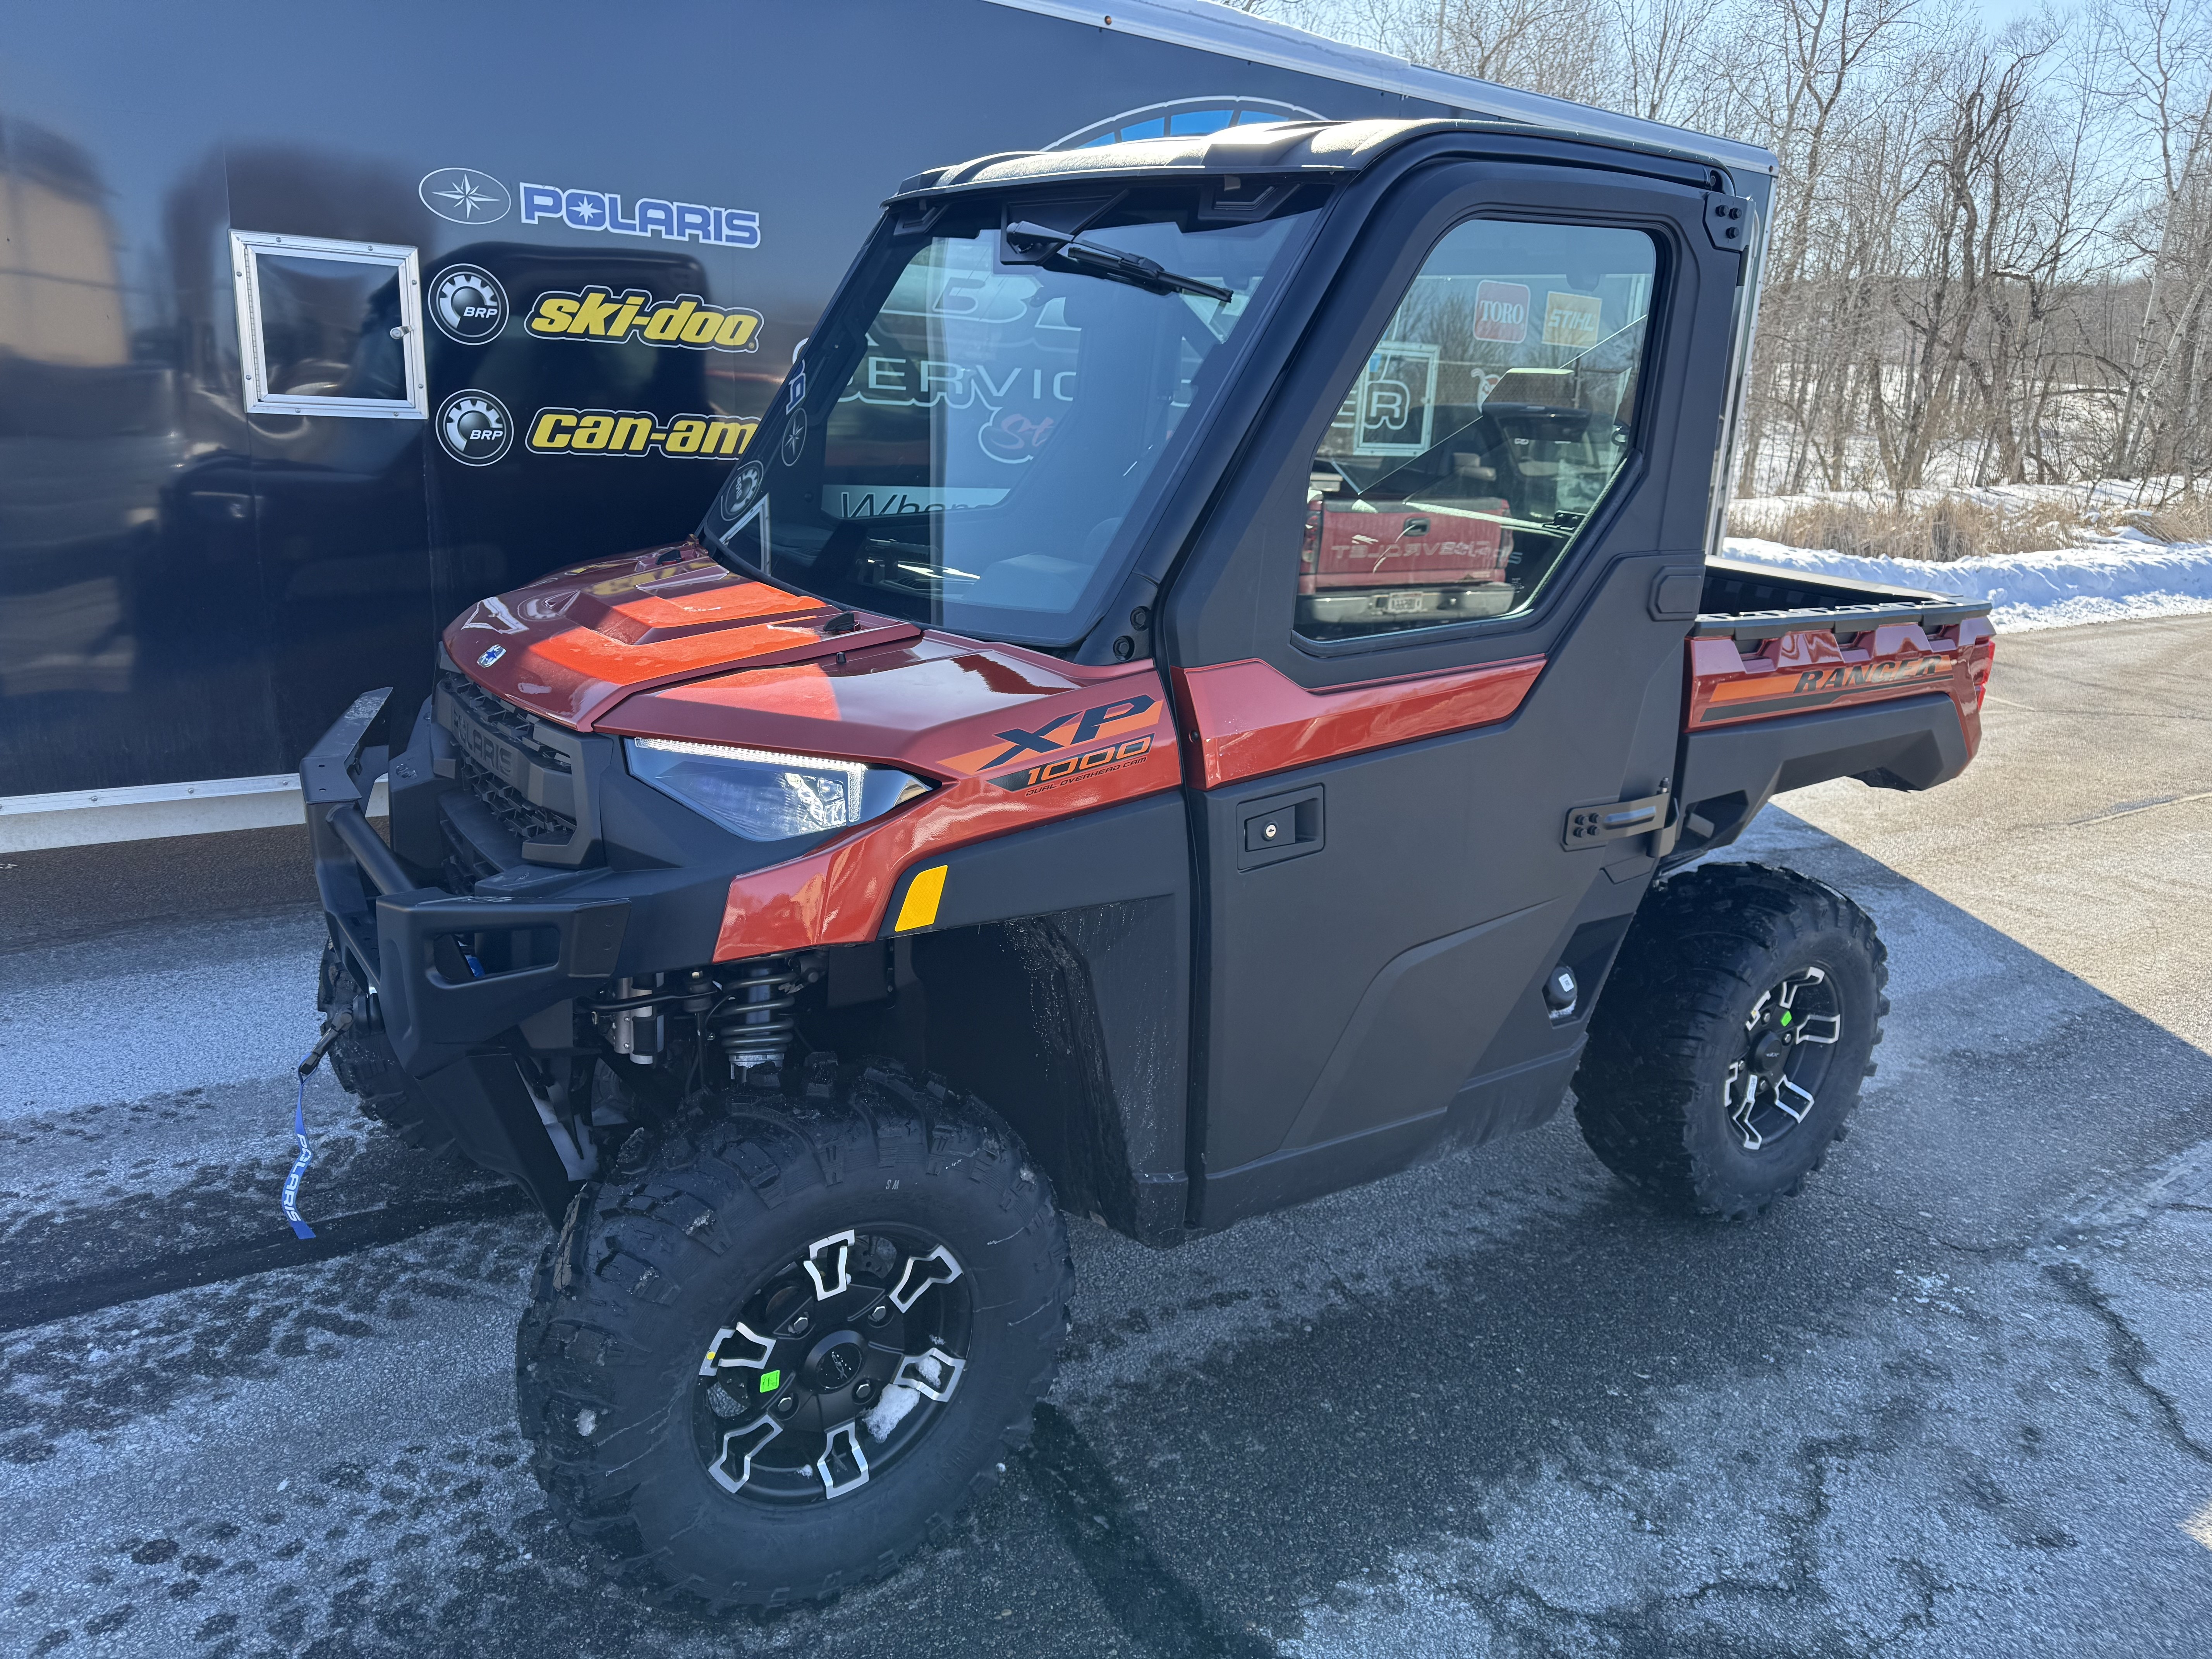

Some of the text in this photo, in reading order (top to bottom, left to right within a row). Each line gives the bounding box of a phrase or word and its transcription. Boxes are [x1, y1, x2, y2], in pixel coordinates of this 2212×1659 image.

[520, 182, 760, 248] POLARIS
[463, 306, 498, 319] BRP
[1479, 300, 1524, 325] TORO
[1549, 309, 1594, 332] STIHL
[469, 429, 503, 440] BRP
[532, 413, 758, 454] can-am
[1793, 655, 1942, 694] RANGER
[452, 706, 512, 776] POLARIS
[975, 694, 1156, 772] XP
[1026, 757, 1147, 796] DUAL OVERHEAD CAM
[1027, 737, 1152, 785] 1000
[284, 1133, 312, 1222] POLARIS
